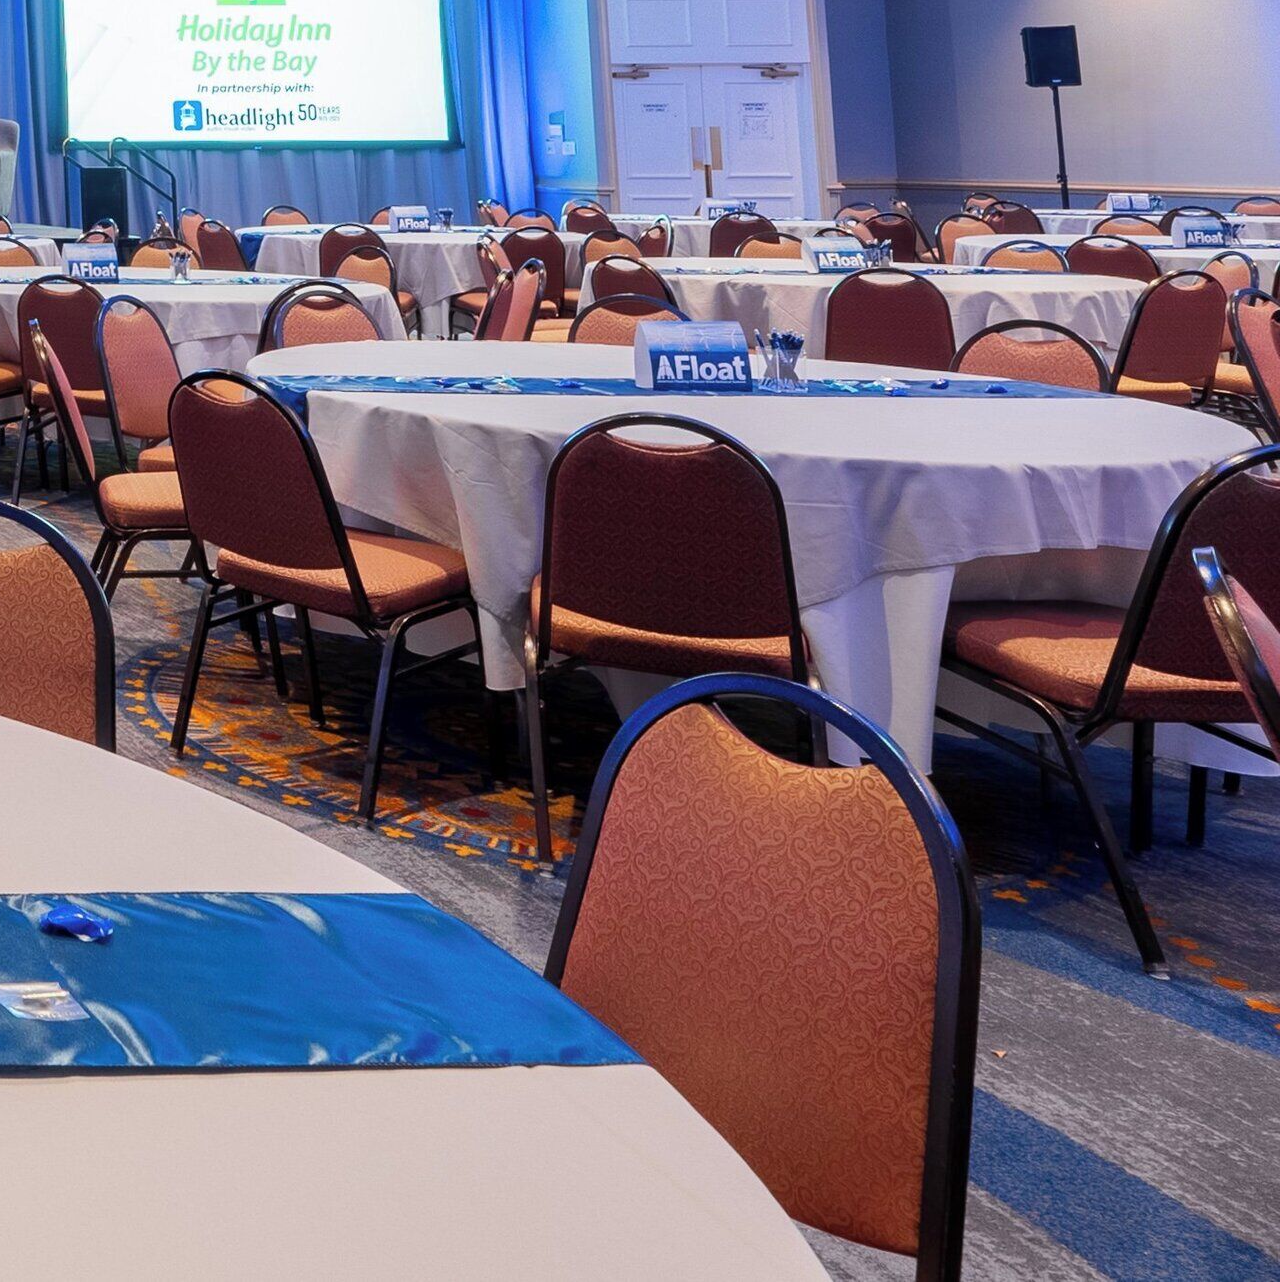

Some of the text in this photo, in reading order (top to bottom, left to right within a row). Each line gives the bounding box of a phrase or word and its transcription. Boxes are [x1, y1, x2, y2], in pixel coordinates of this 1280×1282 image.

[177, 14, 332, 48] Holiday Inn
[192, 49, 318, 78] By the Bay
[197, 83, 315, 95] In partnership with:
[206, 103, 341, 132] headlight 50 YEARS
[399, 218, 430, 230] AFloat
[1186, 231, 1224, 245] AFloat
[818, 253, 865, 268] AFloat
[71, 262, 117, 278] AFloat
[656, 355, 747, 381] AFloat
